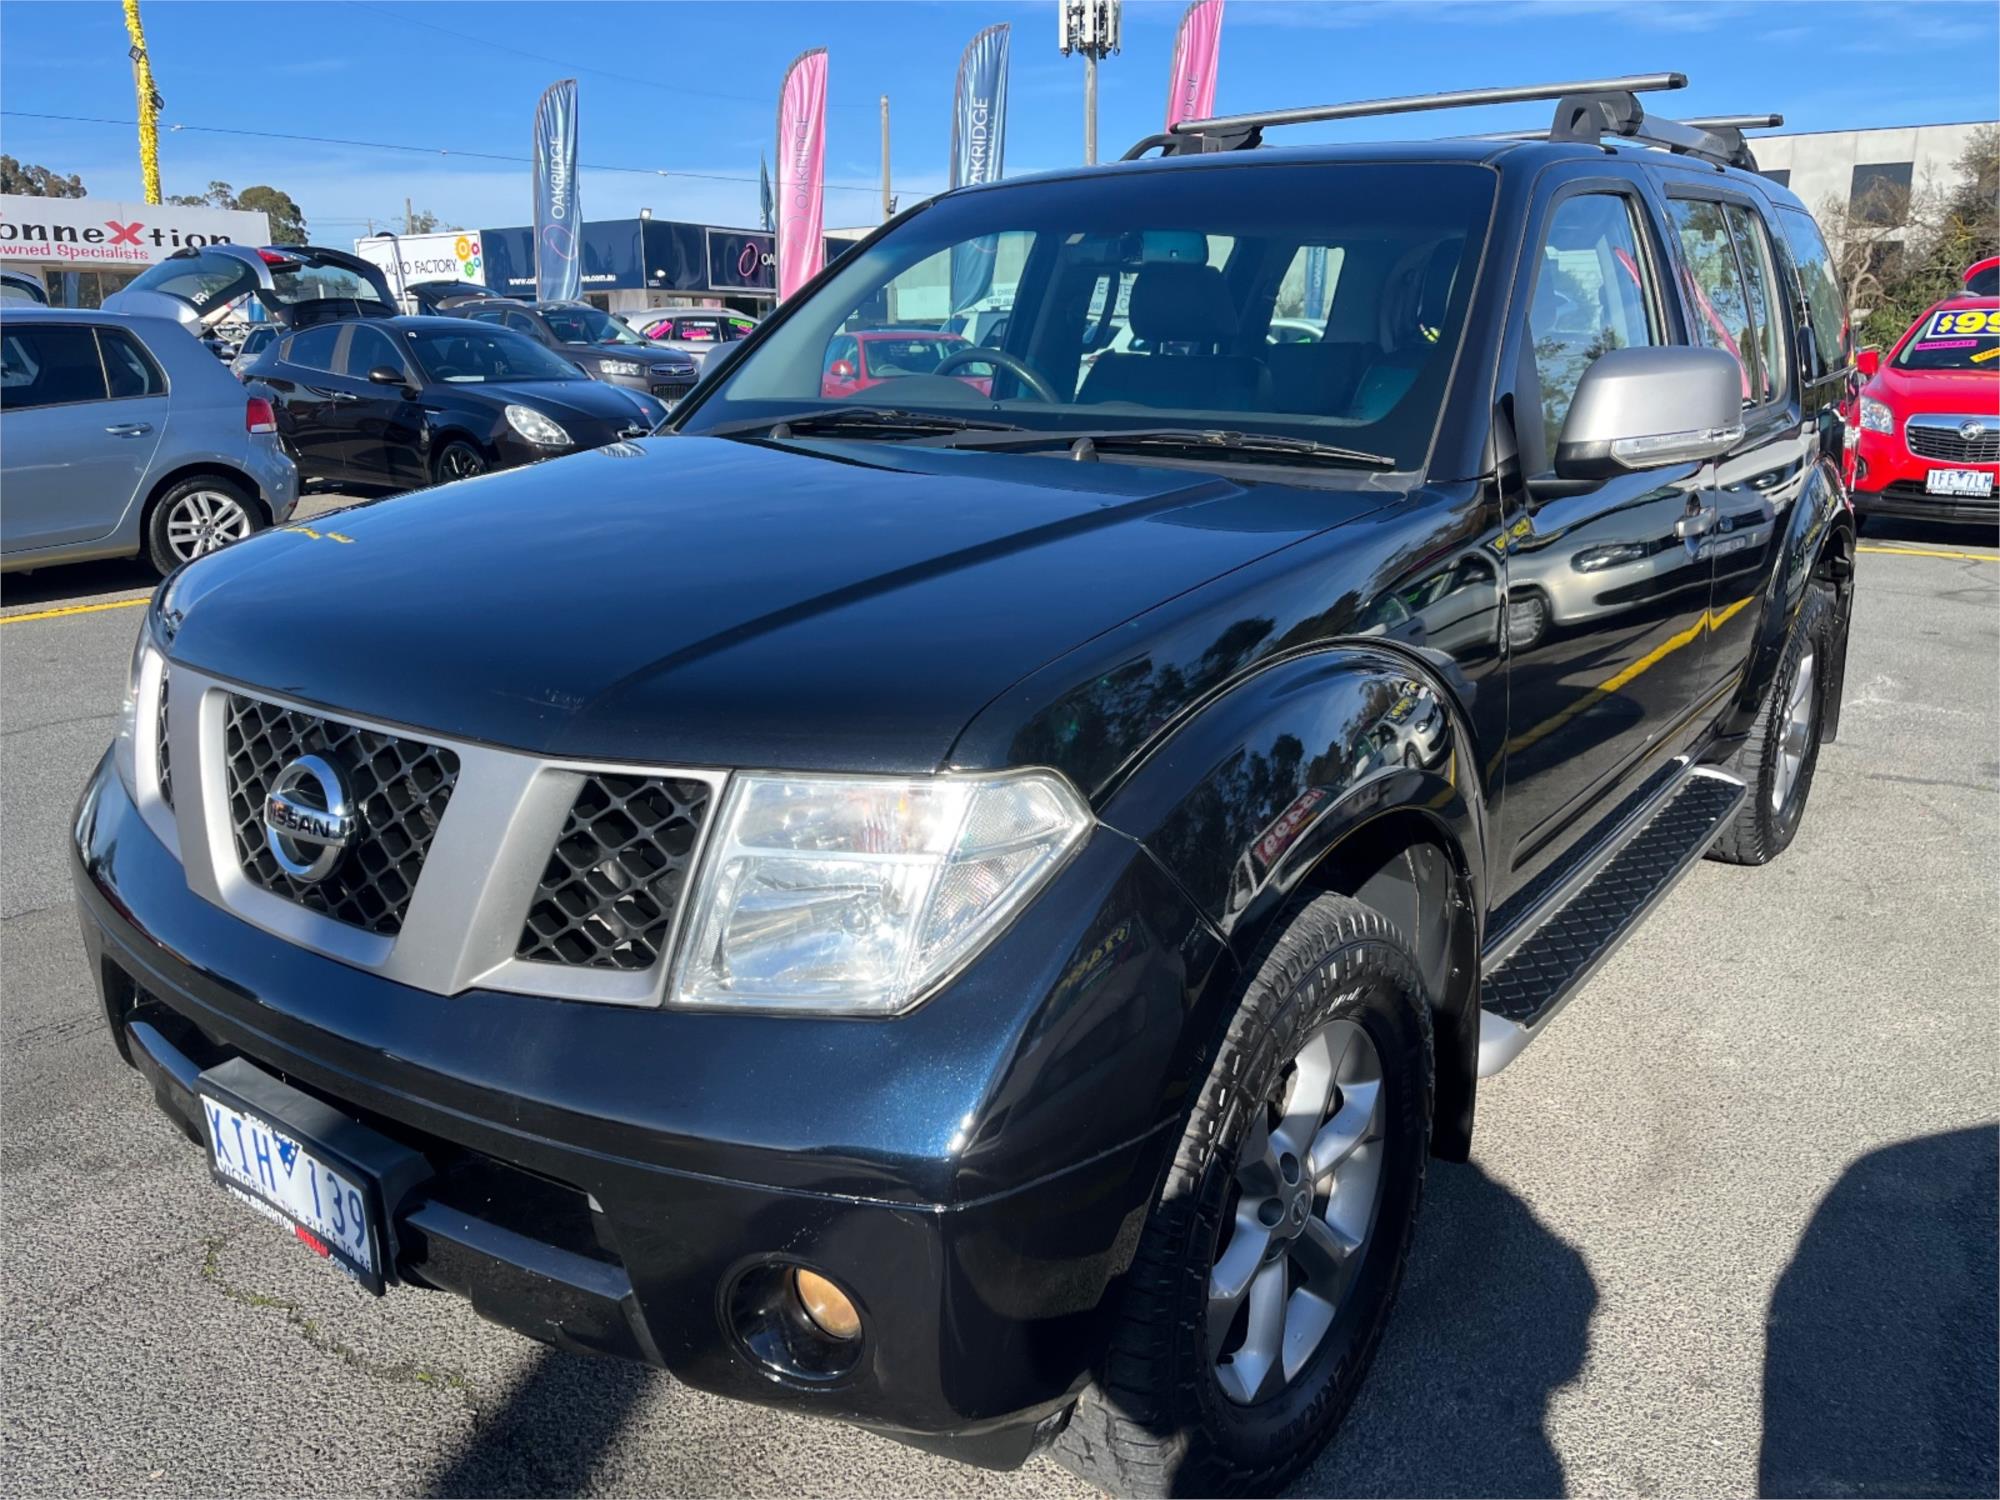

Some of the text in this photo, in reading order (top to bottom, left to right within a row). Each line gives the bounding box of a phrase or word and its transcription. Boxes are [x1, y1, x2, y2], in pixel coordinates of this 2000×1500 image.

[551, 136, 566, 219] OAKRIDGE
[795, 118, 810, 210] OAKRIDGE
[969, 97, 989, 185] AKRIDGE
[56, 244, 149, 260] Specialists
[414, 259, 457, 275] FACTORY
[205, 1103, 366, 1249] XIH 139
